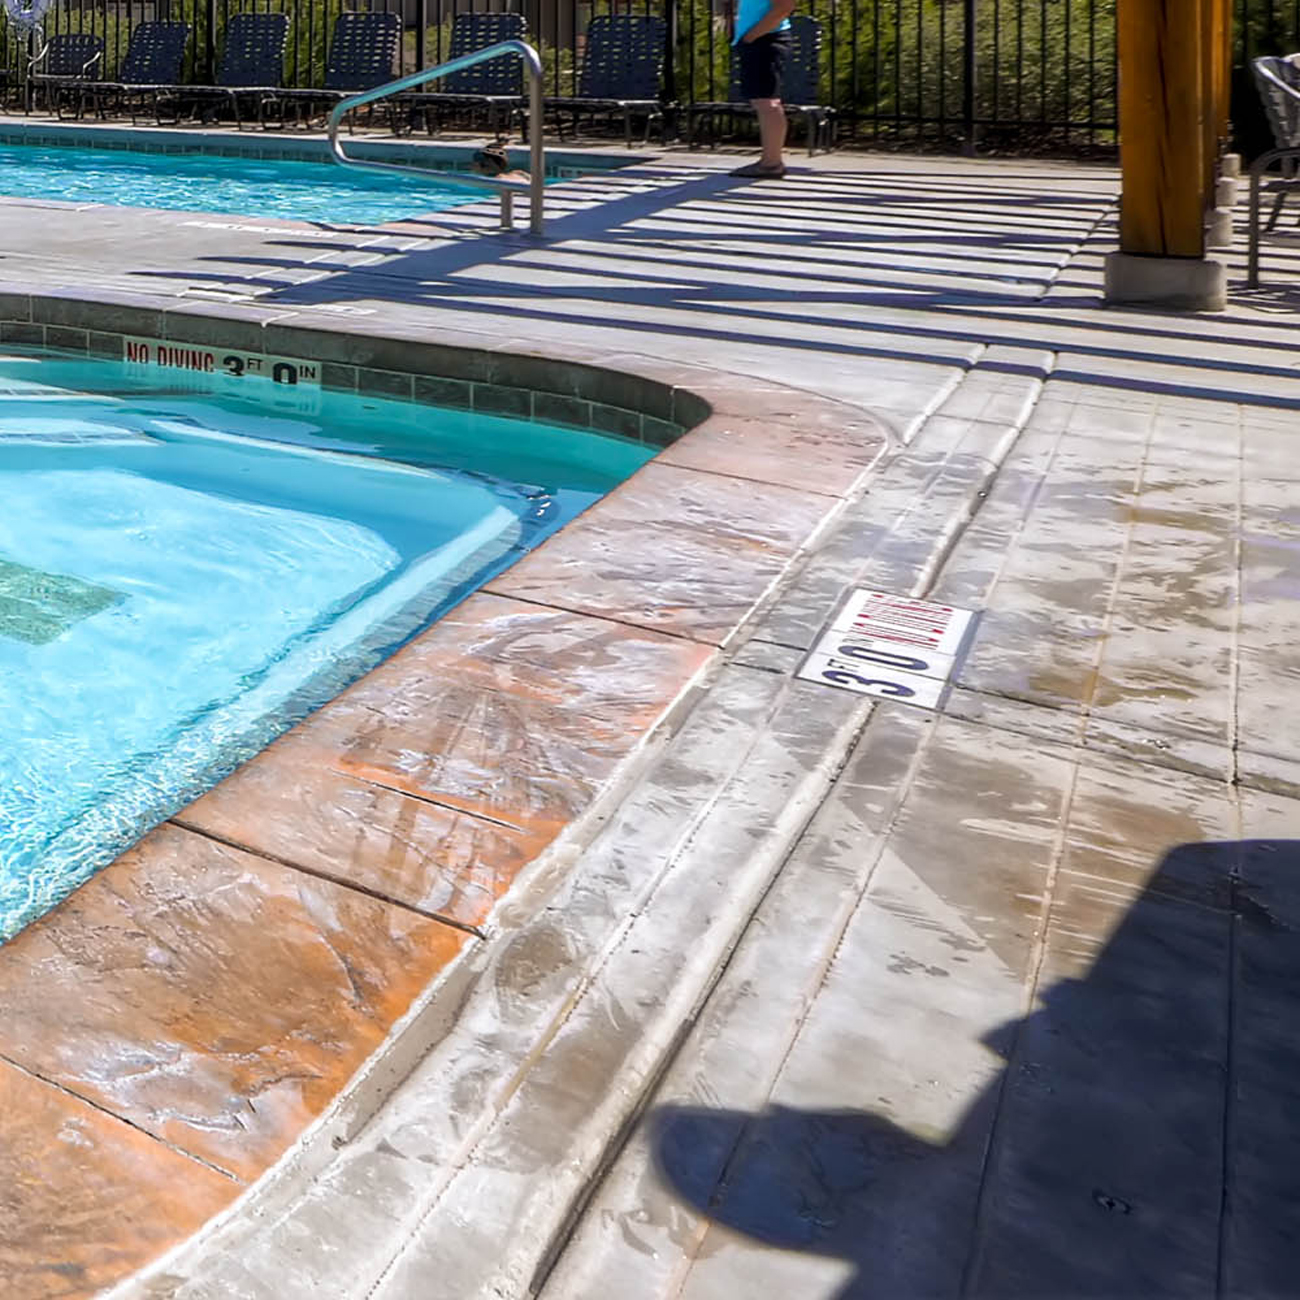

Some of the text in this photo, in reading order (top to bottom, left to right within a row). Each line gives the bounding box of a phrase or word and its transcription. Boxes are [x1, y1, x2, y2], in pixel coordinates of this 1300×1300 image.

[127, 341, 316, 385] NO DIVING 3 FT 0 IN
[838, 644, 930, 670] 0
[821, 670, 916, 697] 3
